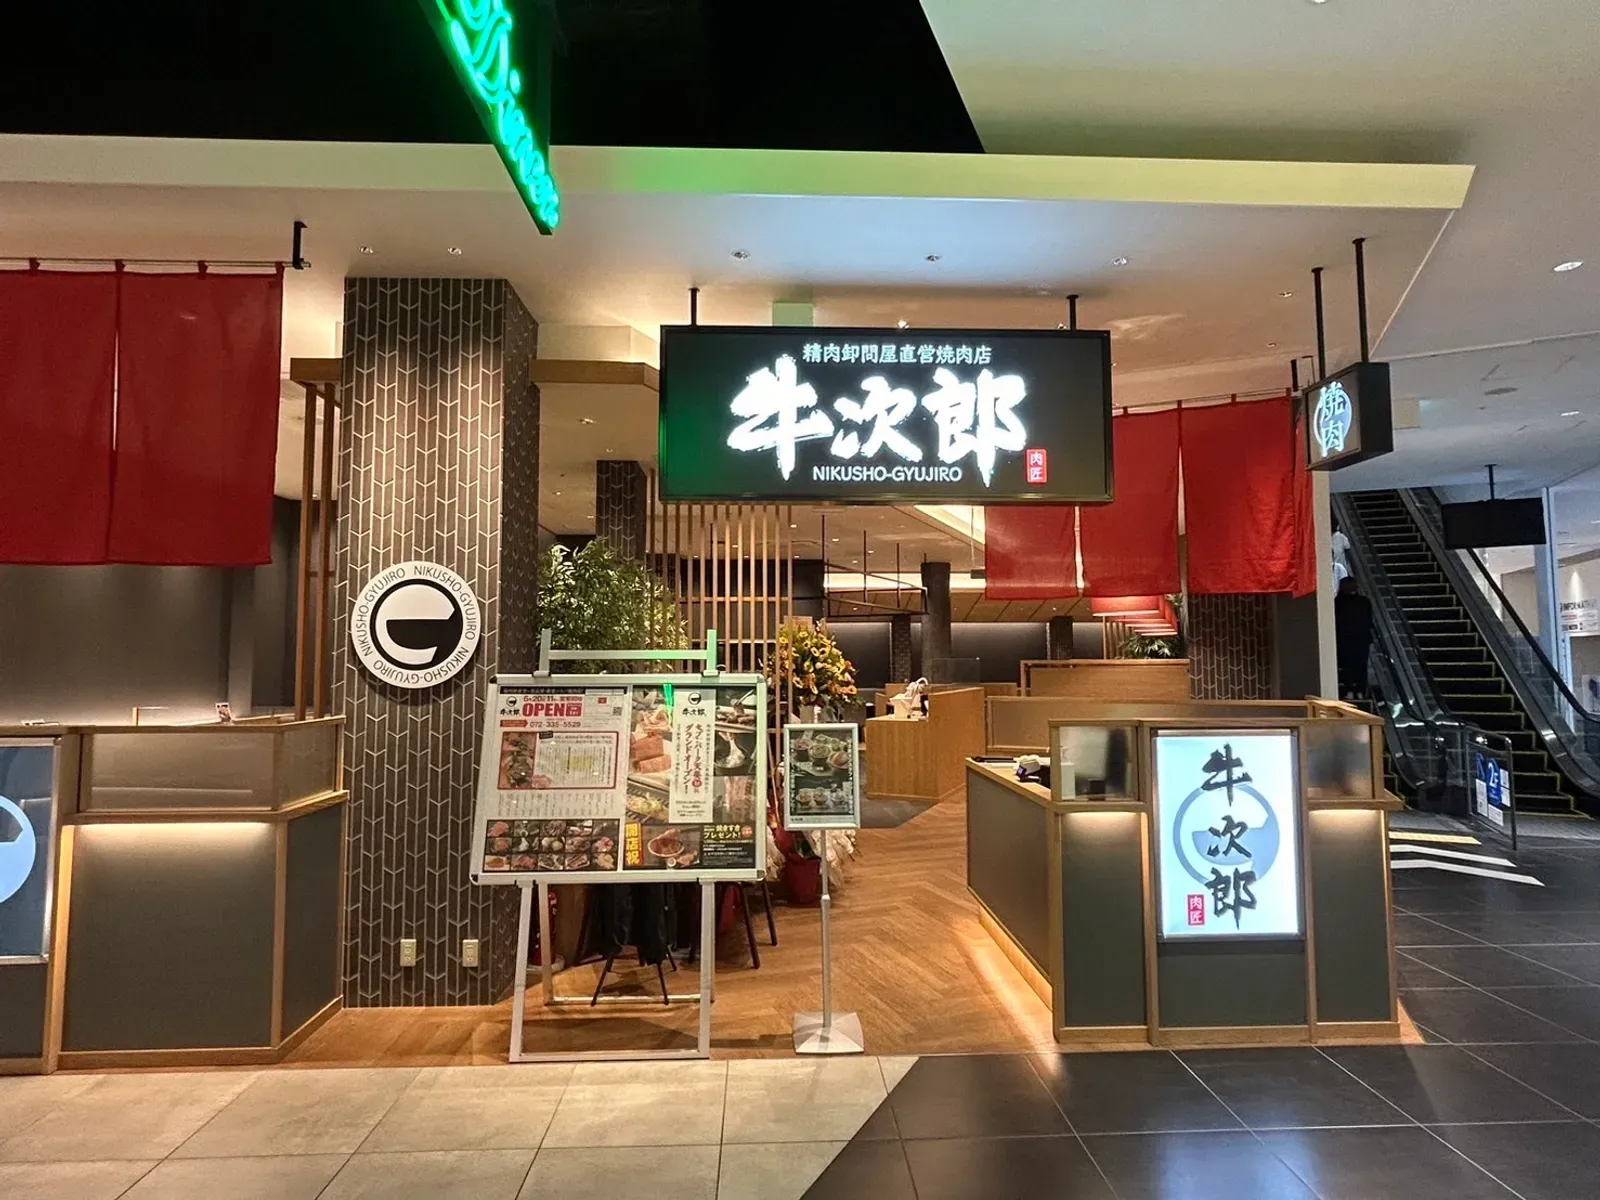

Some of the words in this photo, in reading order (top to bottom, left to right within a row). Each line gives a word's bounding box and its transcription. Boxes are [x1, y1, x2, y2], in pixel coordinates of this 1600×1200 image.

[802, 343, 992, 365] 精肉卸問屋直営焼肉店
[727, 354, 1027, 487] 牛次郎
[1318, 380, 1347, 457] 焼肉
[812, 465, 963, 482] NIKUSHO-GYUJIRO
[1029, 452, 1045, 481] 肉匠
[355, 567, 406, 657] NIKUSHO-GYUJIRO
[413, 565, 477, 641] NIKUSHO-GYUJIRO
[373, 646, 470, 684] NIKUSHO-GYUJIRO
[522, 703, 565, 716] OPEN
[1201, 742, 1258, 930] 牛次郎
[1189, 896, 1204, 924] 肉匠
